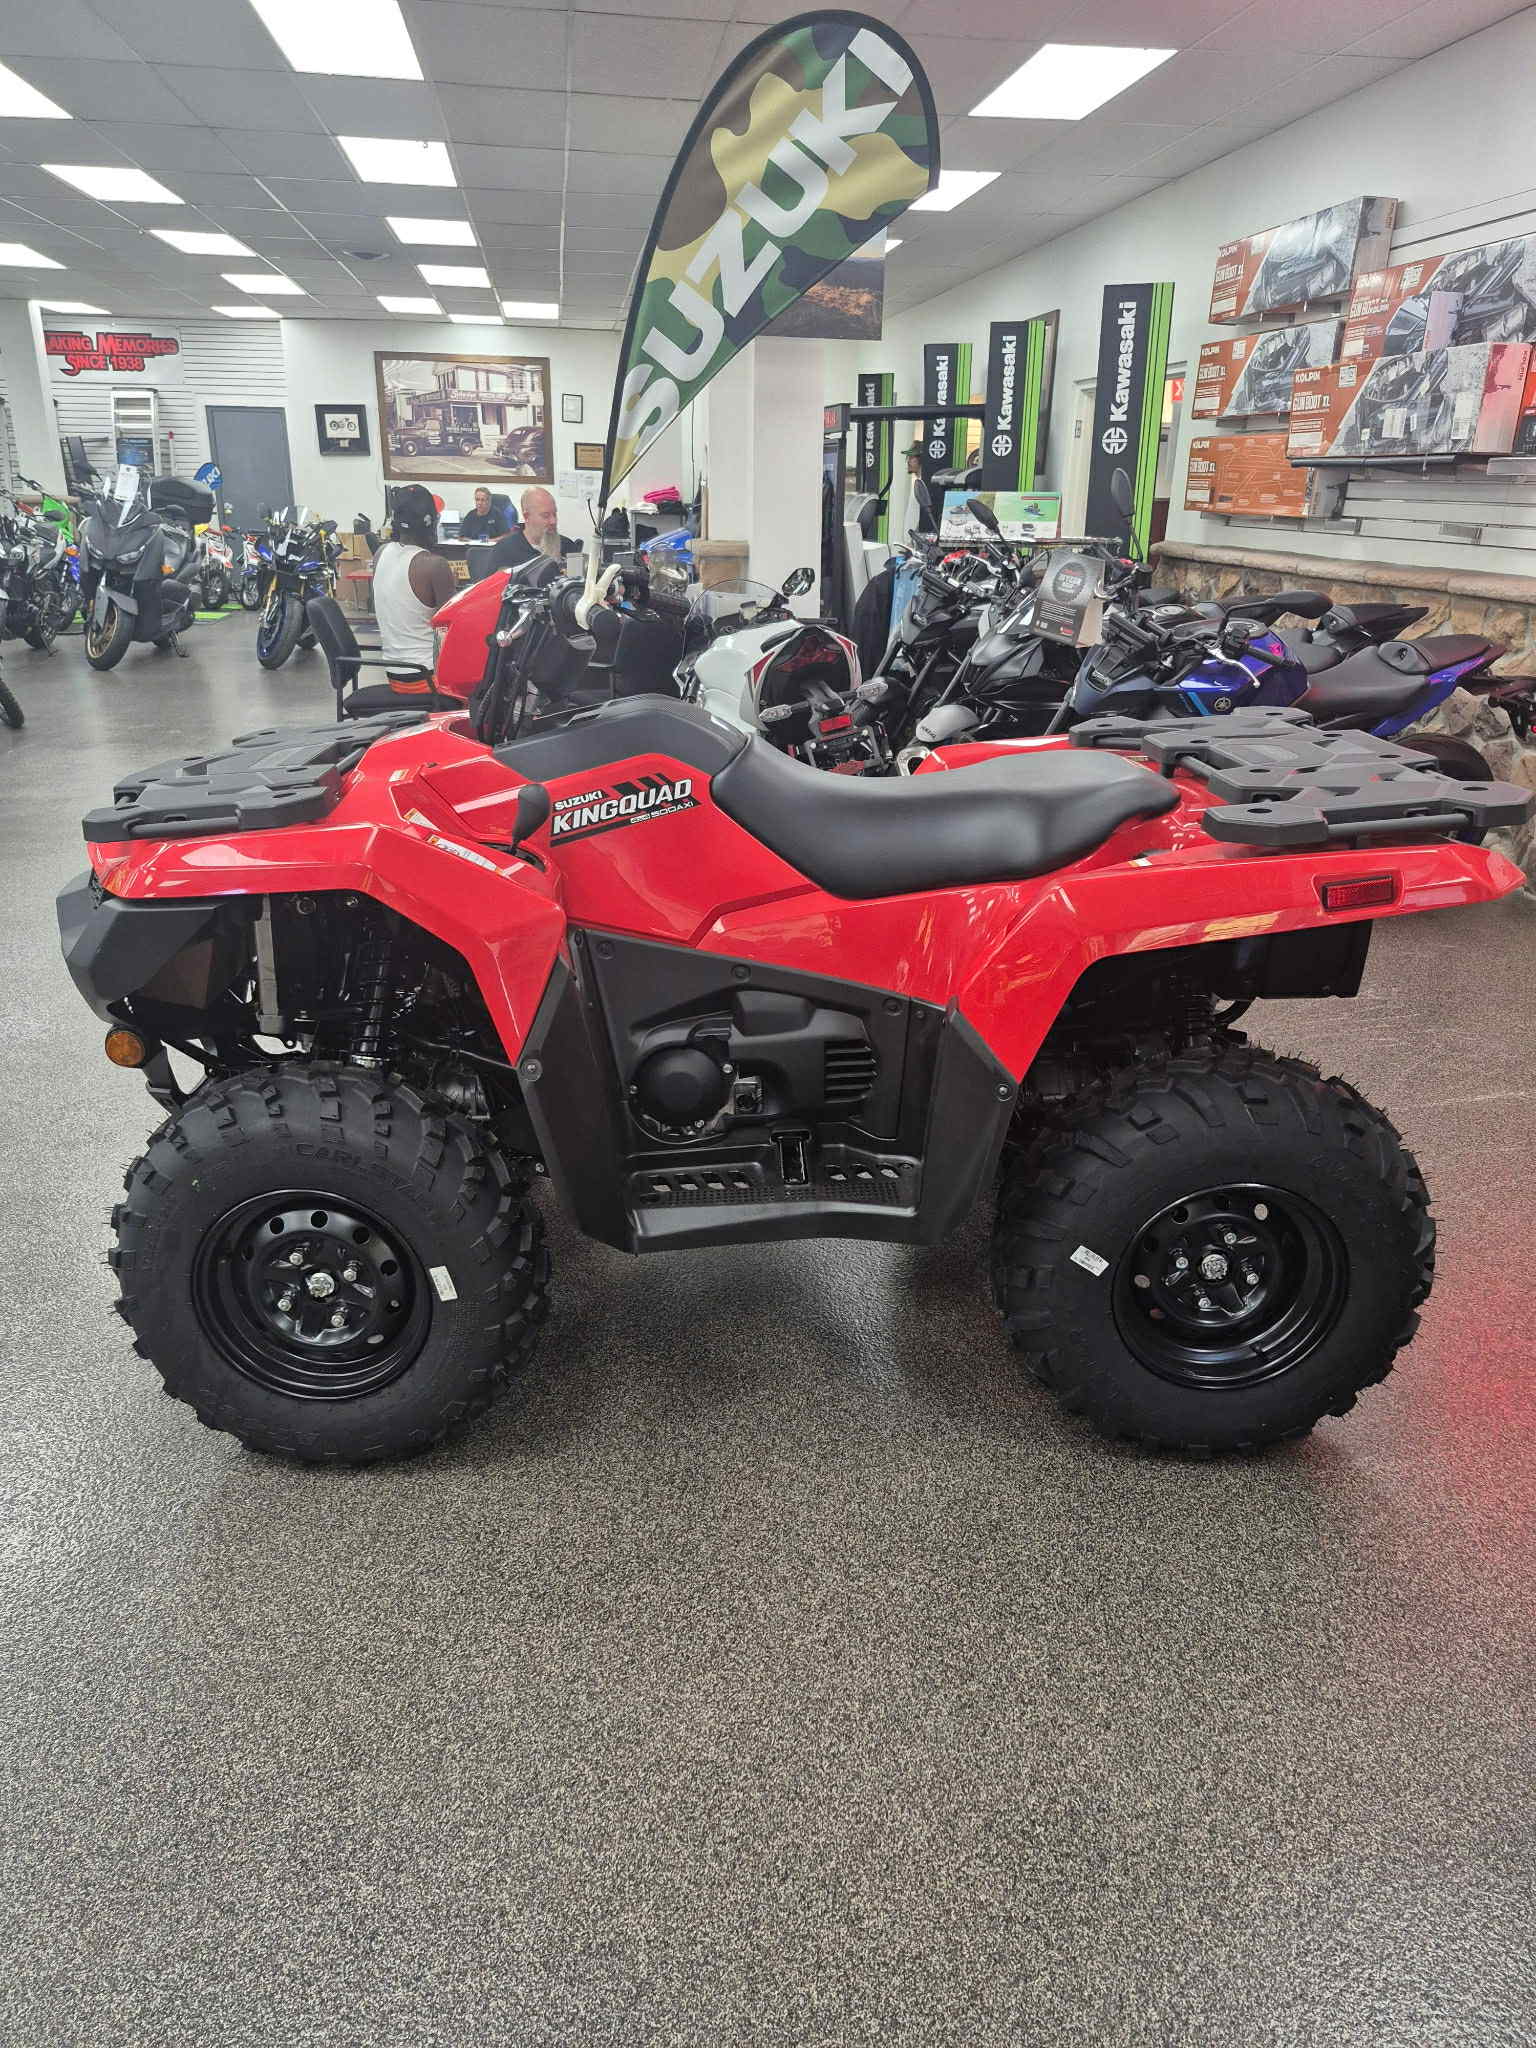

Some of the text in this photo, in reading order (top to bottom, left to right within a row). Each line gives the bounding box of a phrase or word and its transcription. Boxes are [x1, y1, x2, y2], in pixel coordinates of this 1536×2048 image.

[618, 28, 914, 456] SUZUKI
[46, 332, 178, 354] AKING MEMORIES
[1110, 301, 1137, 421] Kawasaki
[60, 354, 145, 376] SINCE 1938
[997, 335, 1016, 430] Kawasaki
[1295, 371, 1320, 384] KOLPIN
[553, 778, 692, 834] KINGQUAD
[554, 790, 603, 811] SUZUKI
